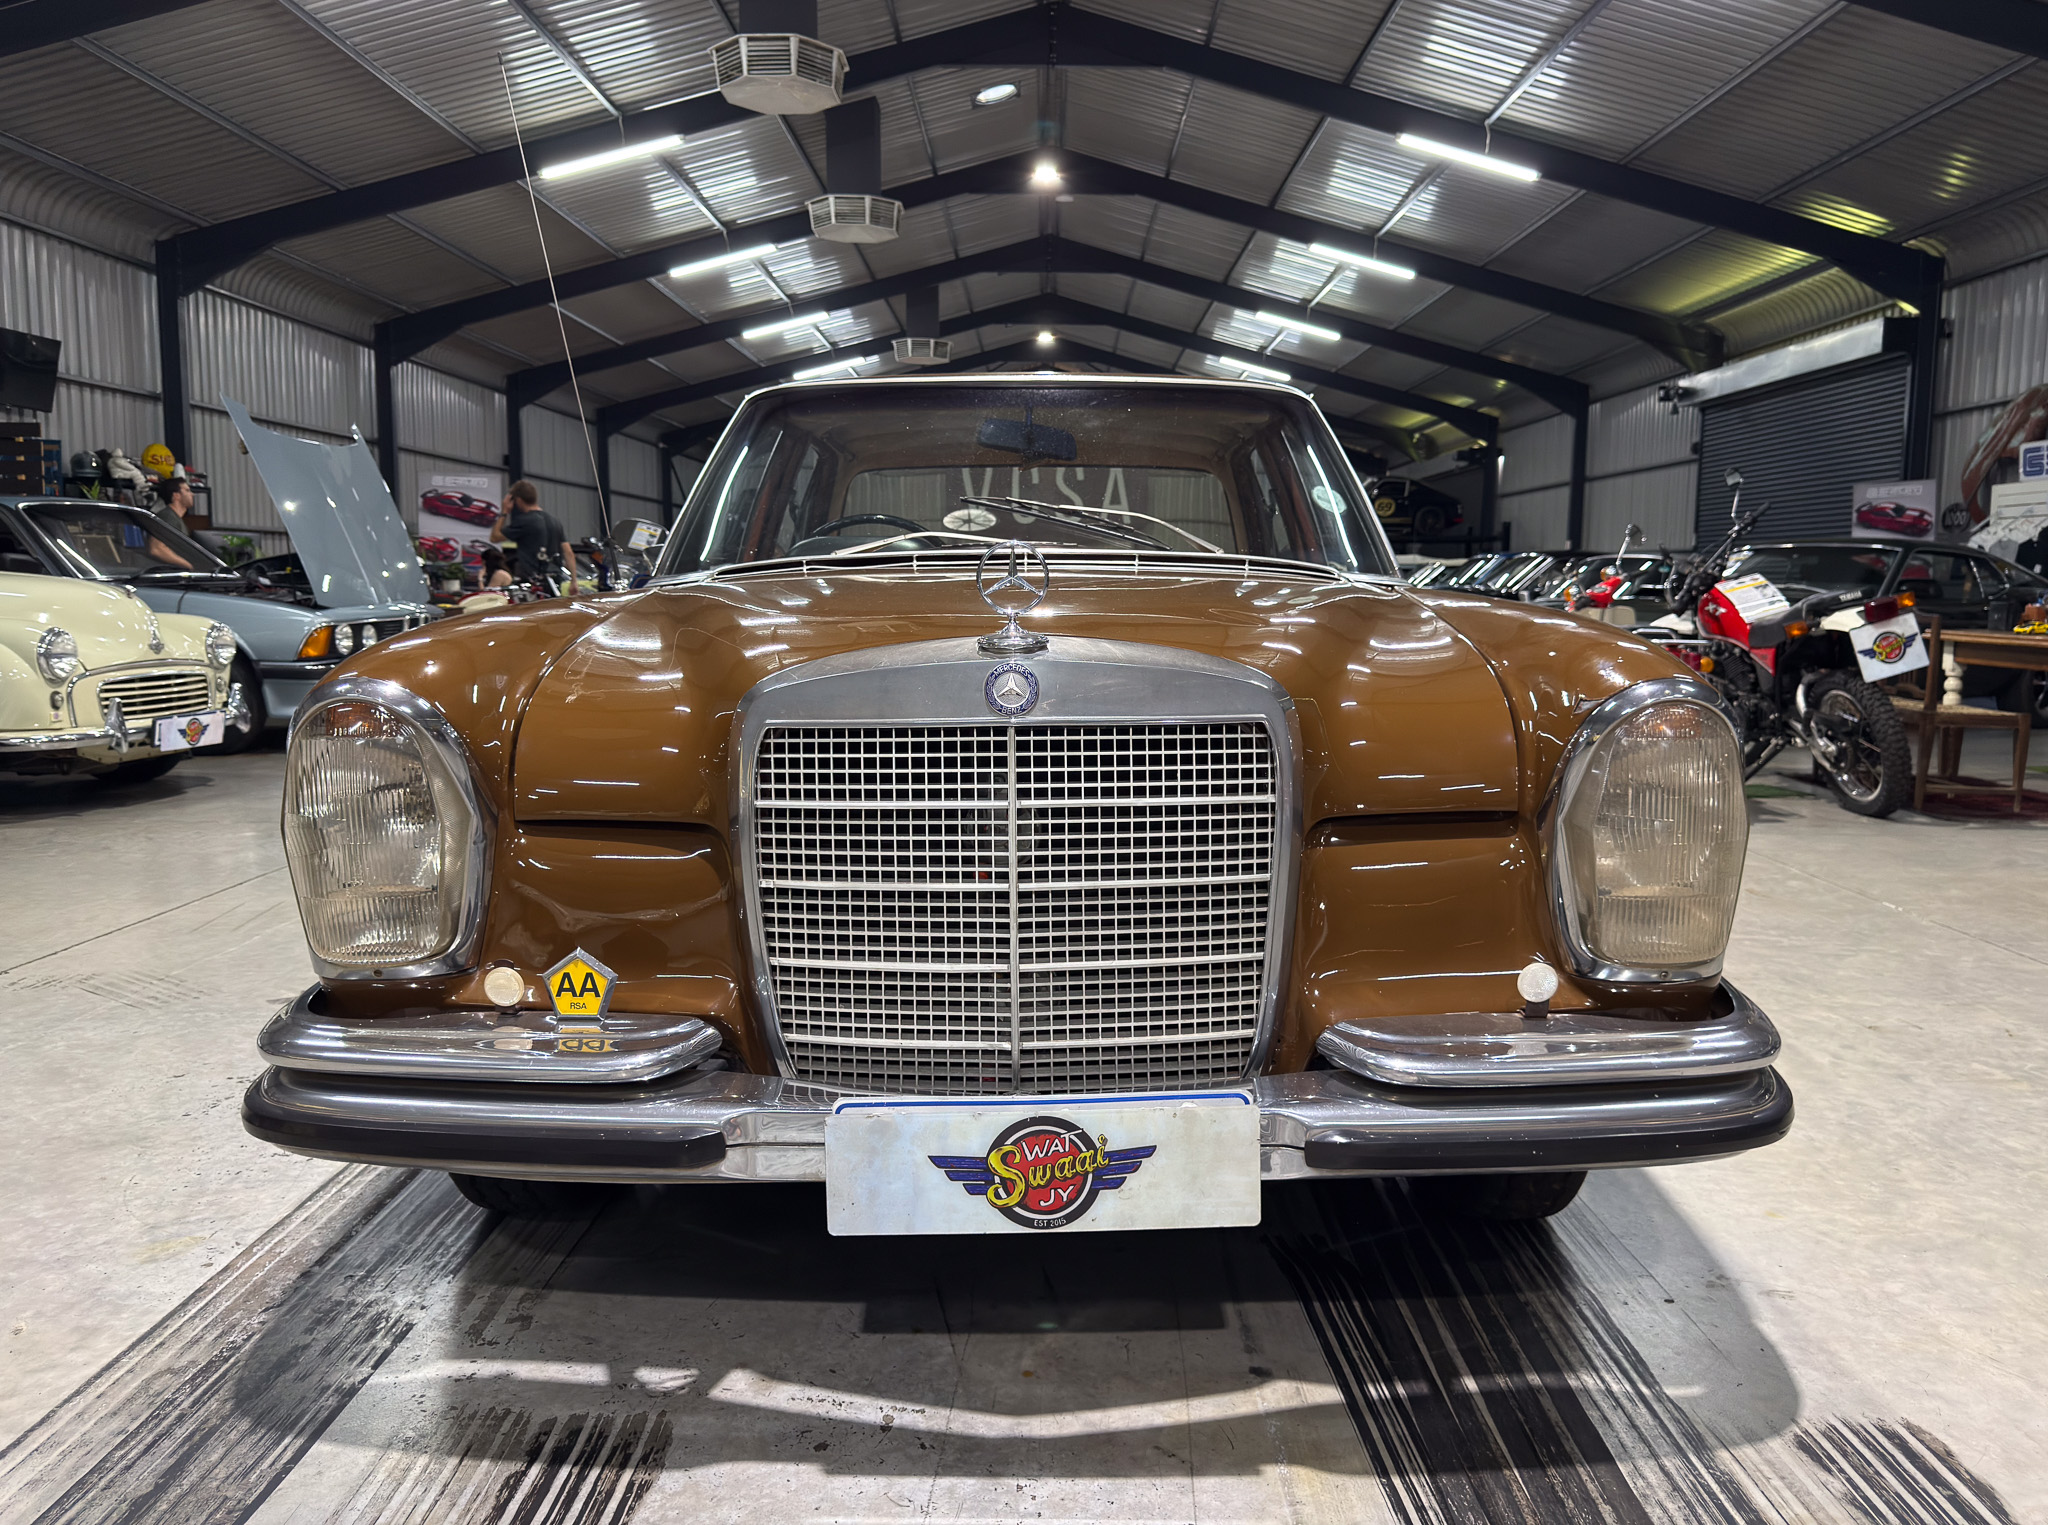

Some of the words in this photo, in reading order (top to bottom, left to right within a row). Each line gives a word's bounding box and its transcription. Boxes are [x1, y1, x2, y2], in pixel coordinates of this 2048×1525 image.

[1704, 601, 1728, 616] XT
[994, 663, 1030, 677] MERCEDES
[1001, 706, 1023, 715] BENZ
[555, 971, 601, 998] AA
[570, 1002, 587, 1010] RSA
[1020, 1129, 1083, 1162] WAT
[986, 1134, 1109, 1209] Swaai
[1039, 1185, 1075, 1207] JY
[1033, 1219, 1047, 1227] EST
[1050, 1218, 1067, 1227] 2015
